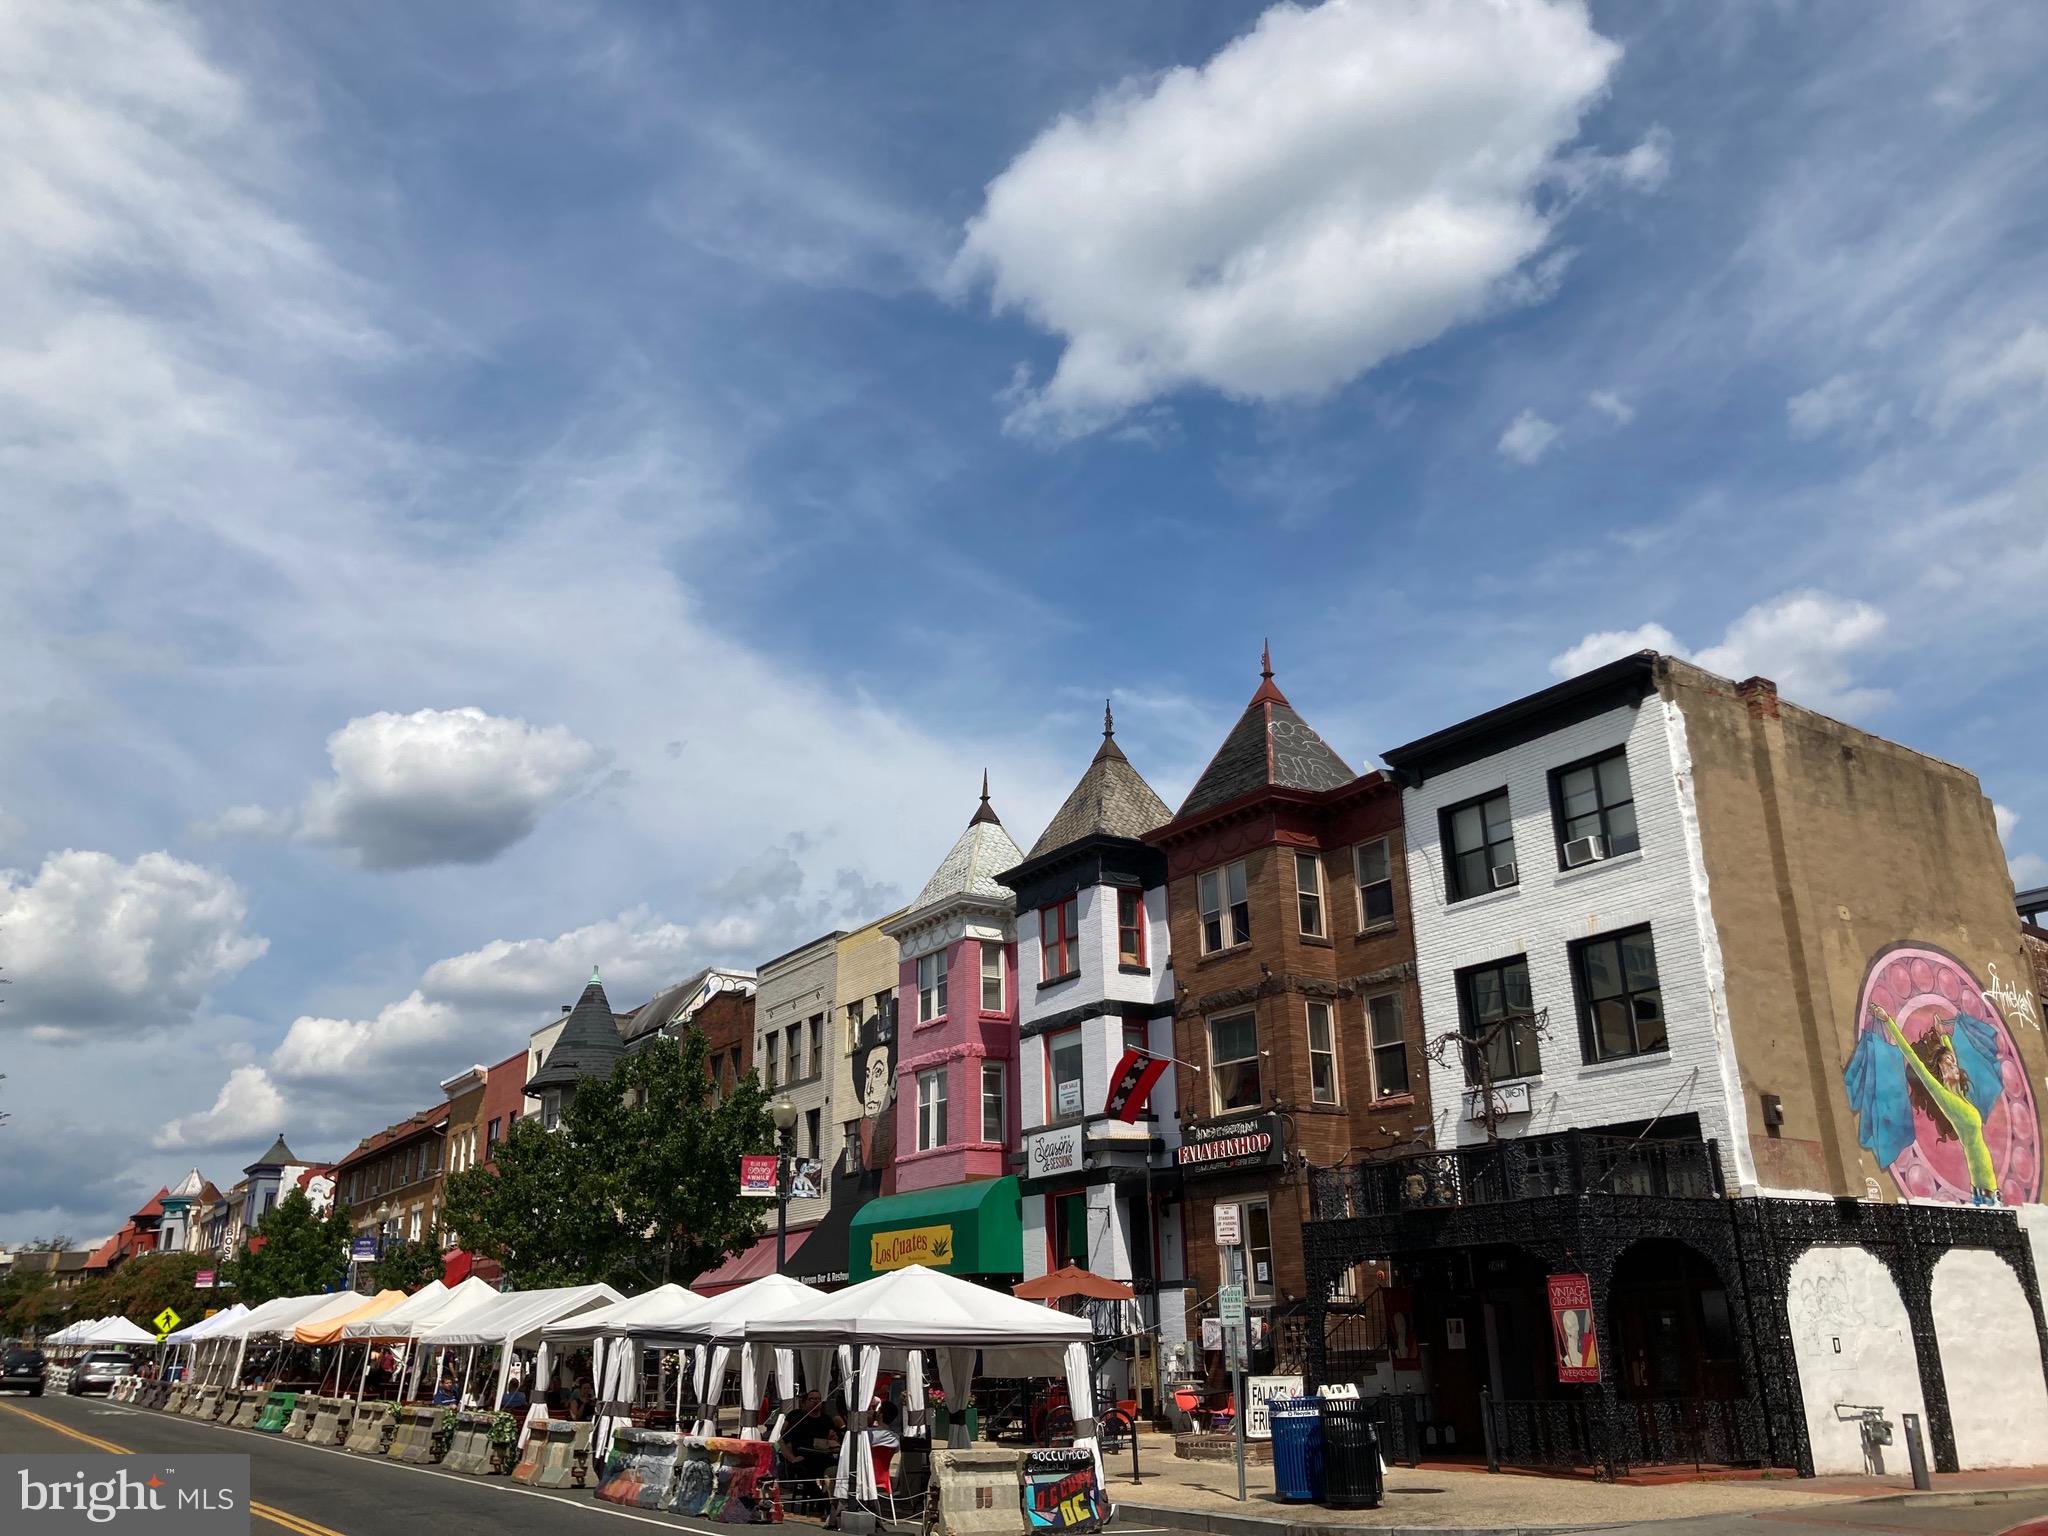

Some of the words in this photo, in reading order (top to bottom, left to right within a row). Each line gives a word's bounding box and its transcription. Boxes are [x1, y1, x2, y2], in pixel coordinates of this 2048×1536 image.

[1034, 1136, 1075, 1163] Seasons
[1178, 1133, 1271, 1165] FALAFELSHOP
[1050, 1154, 1073, 1170] SESSIONS
[875, 1241, 892, 1265] Los
[892, 1233, 928, 1262] Cuates
[817, 1273, 826, 1284] Bar
[826, 1272, 832, 1282] &
[1551, 1285, 1587, 1298] VINTAGE
[1552, 1296, 1589, 1307] CLOTHING
[1561, 1369, 1598, 1377] WEEKENDS
[1059, 1492, 1092, 1527] DC
